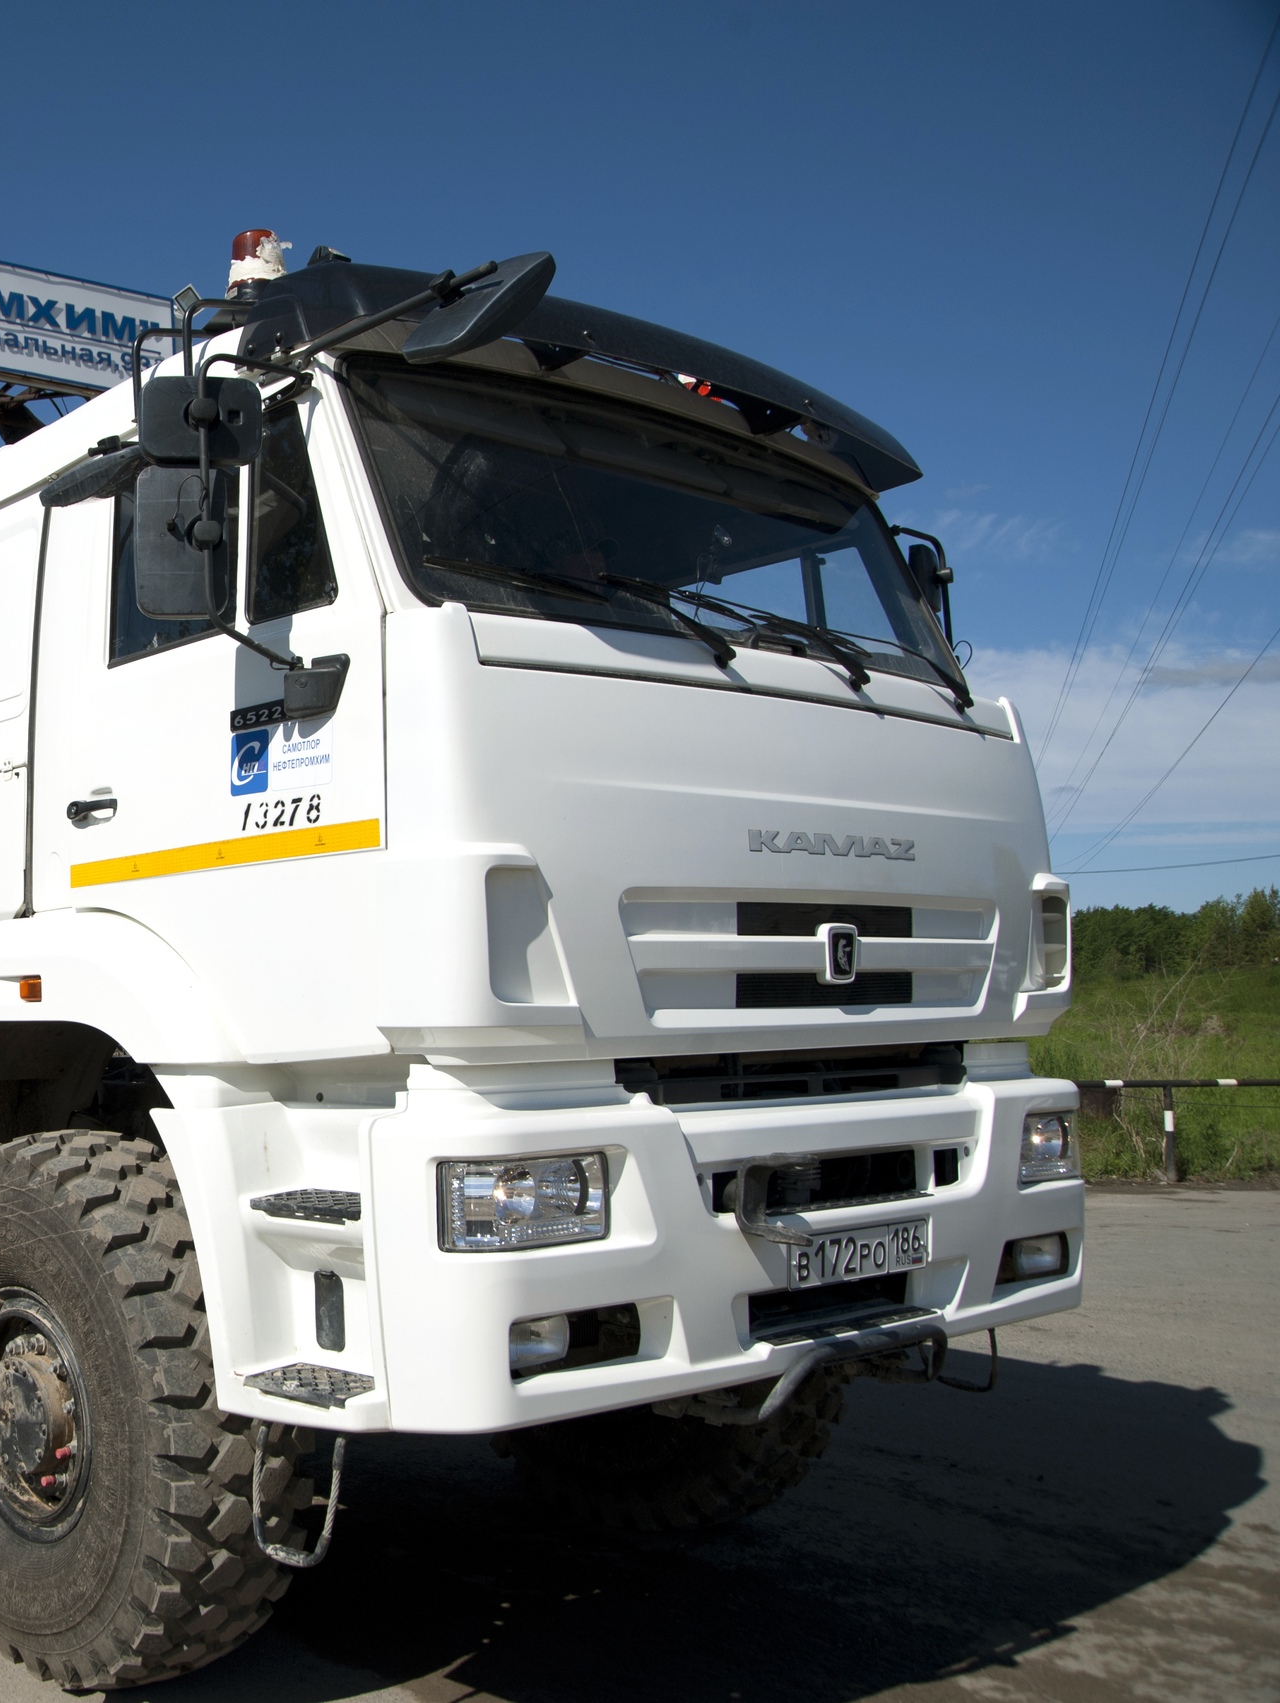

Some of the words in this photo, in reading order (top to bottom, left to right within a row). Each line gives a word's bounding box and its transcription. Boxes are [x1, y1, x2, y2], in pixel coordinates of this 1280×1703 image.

[234, 706, 289, 727] 6522
[282, 738, 321, 754] САМОТЛОР
[272, 753, 331, 772] НЕФТЕПРОМХИМ
[241, 793, 321, 831] 13278
[748, 829, 916, 861] KAMAZ
[895, 1255, 912, 1267] RUS
